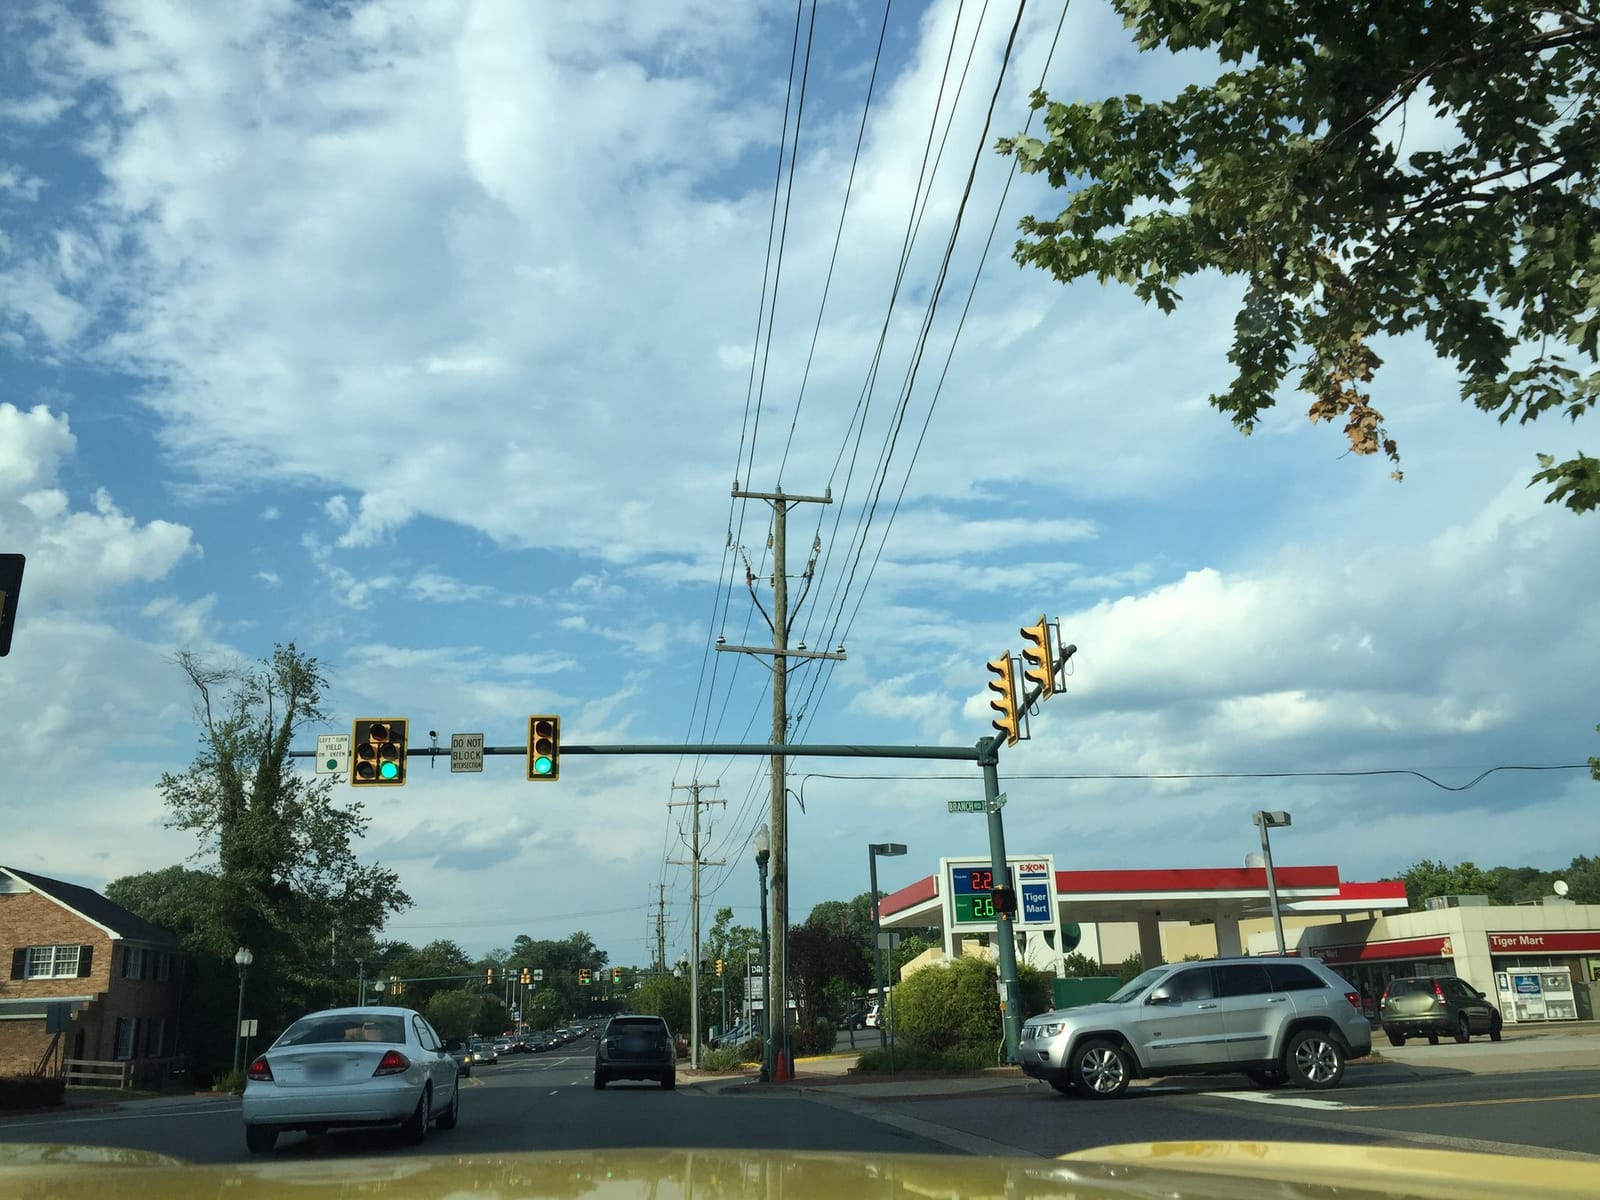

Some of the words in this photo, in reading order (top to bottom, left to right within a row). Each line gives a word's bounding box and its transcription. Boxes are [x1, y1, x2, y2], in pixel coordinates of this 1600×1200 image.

[453, 739, 464, 748] DO
[466, 738, 482, 748] NOT
[452, 751, 481, 761] BLOCK
[948, 802, 973, 811] BRANCH
[1019, 863, 1045, 872] EXXON
[971, 872, 992, 890] 2.2
[1023, 893, 1046, 902] Tiger
[974, 899, 994, 916] 2.6
[1490, 936, 1517, 948] Tiger
[1519, 935, 1545, 945] Mart
